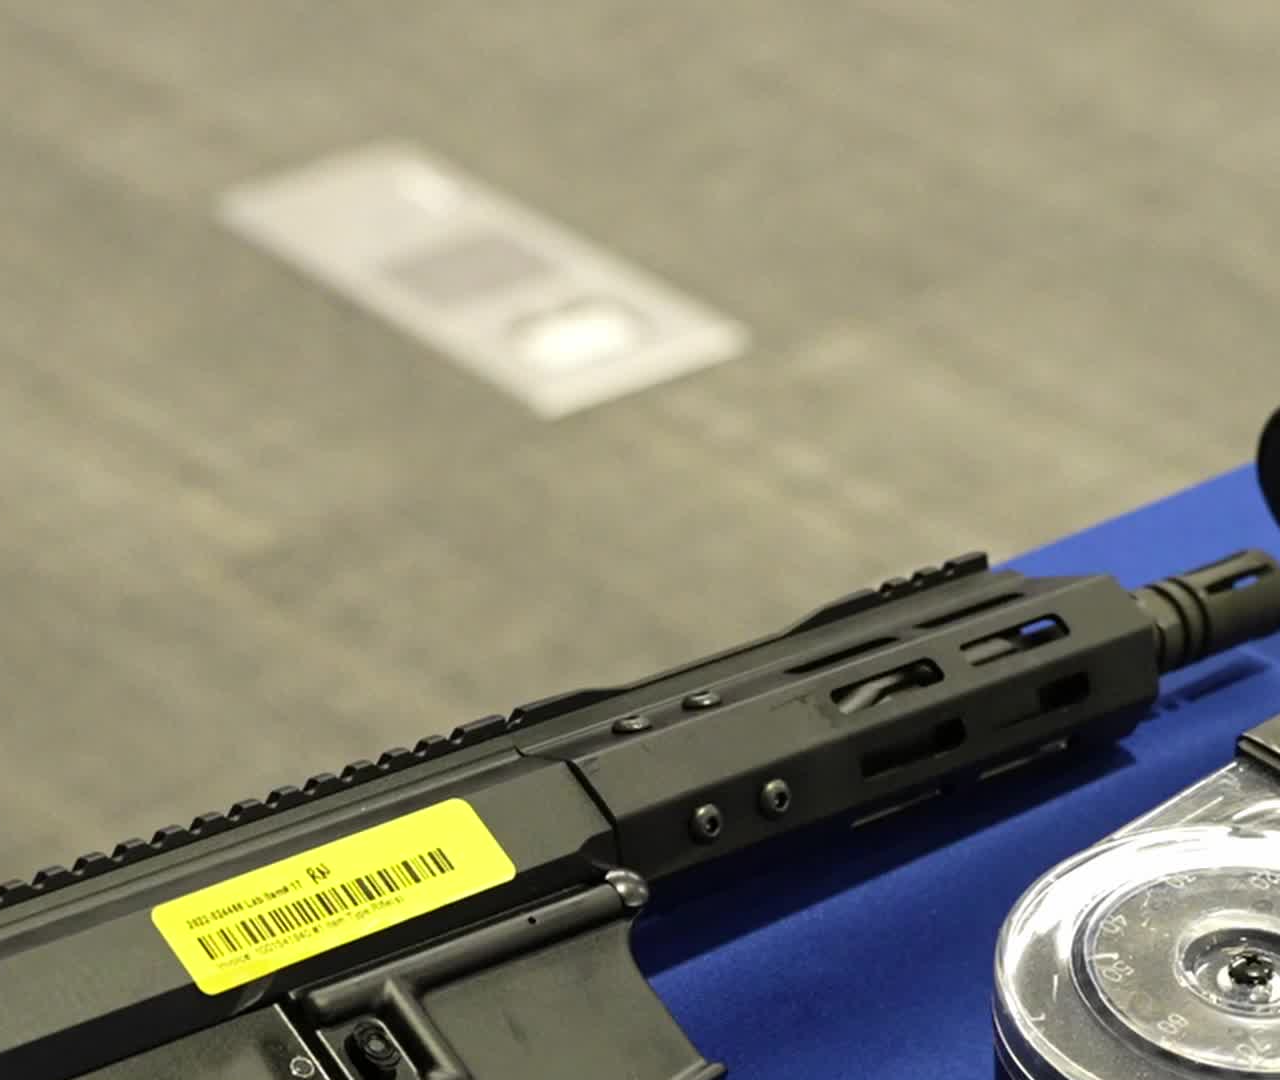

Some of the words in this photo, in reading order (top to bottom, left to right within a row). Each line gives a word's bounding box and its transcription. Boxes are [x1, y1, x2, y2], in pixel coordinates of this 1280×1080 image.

[1102, 960, 1134, 983] 50
[1158, 1013, 1188, 1034] 60
[1237, 1037, 1271, 1060] 70
